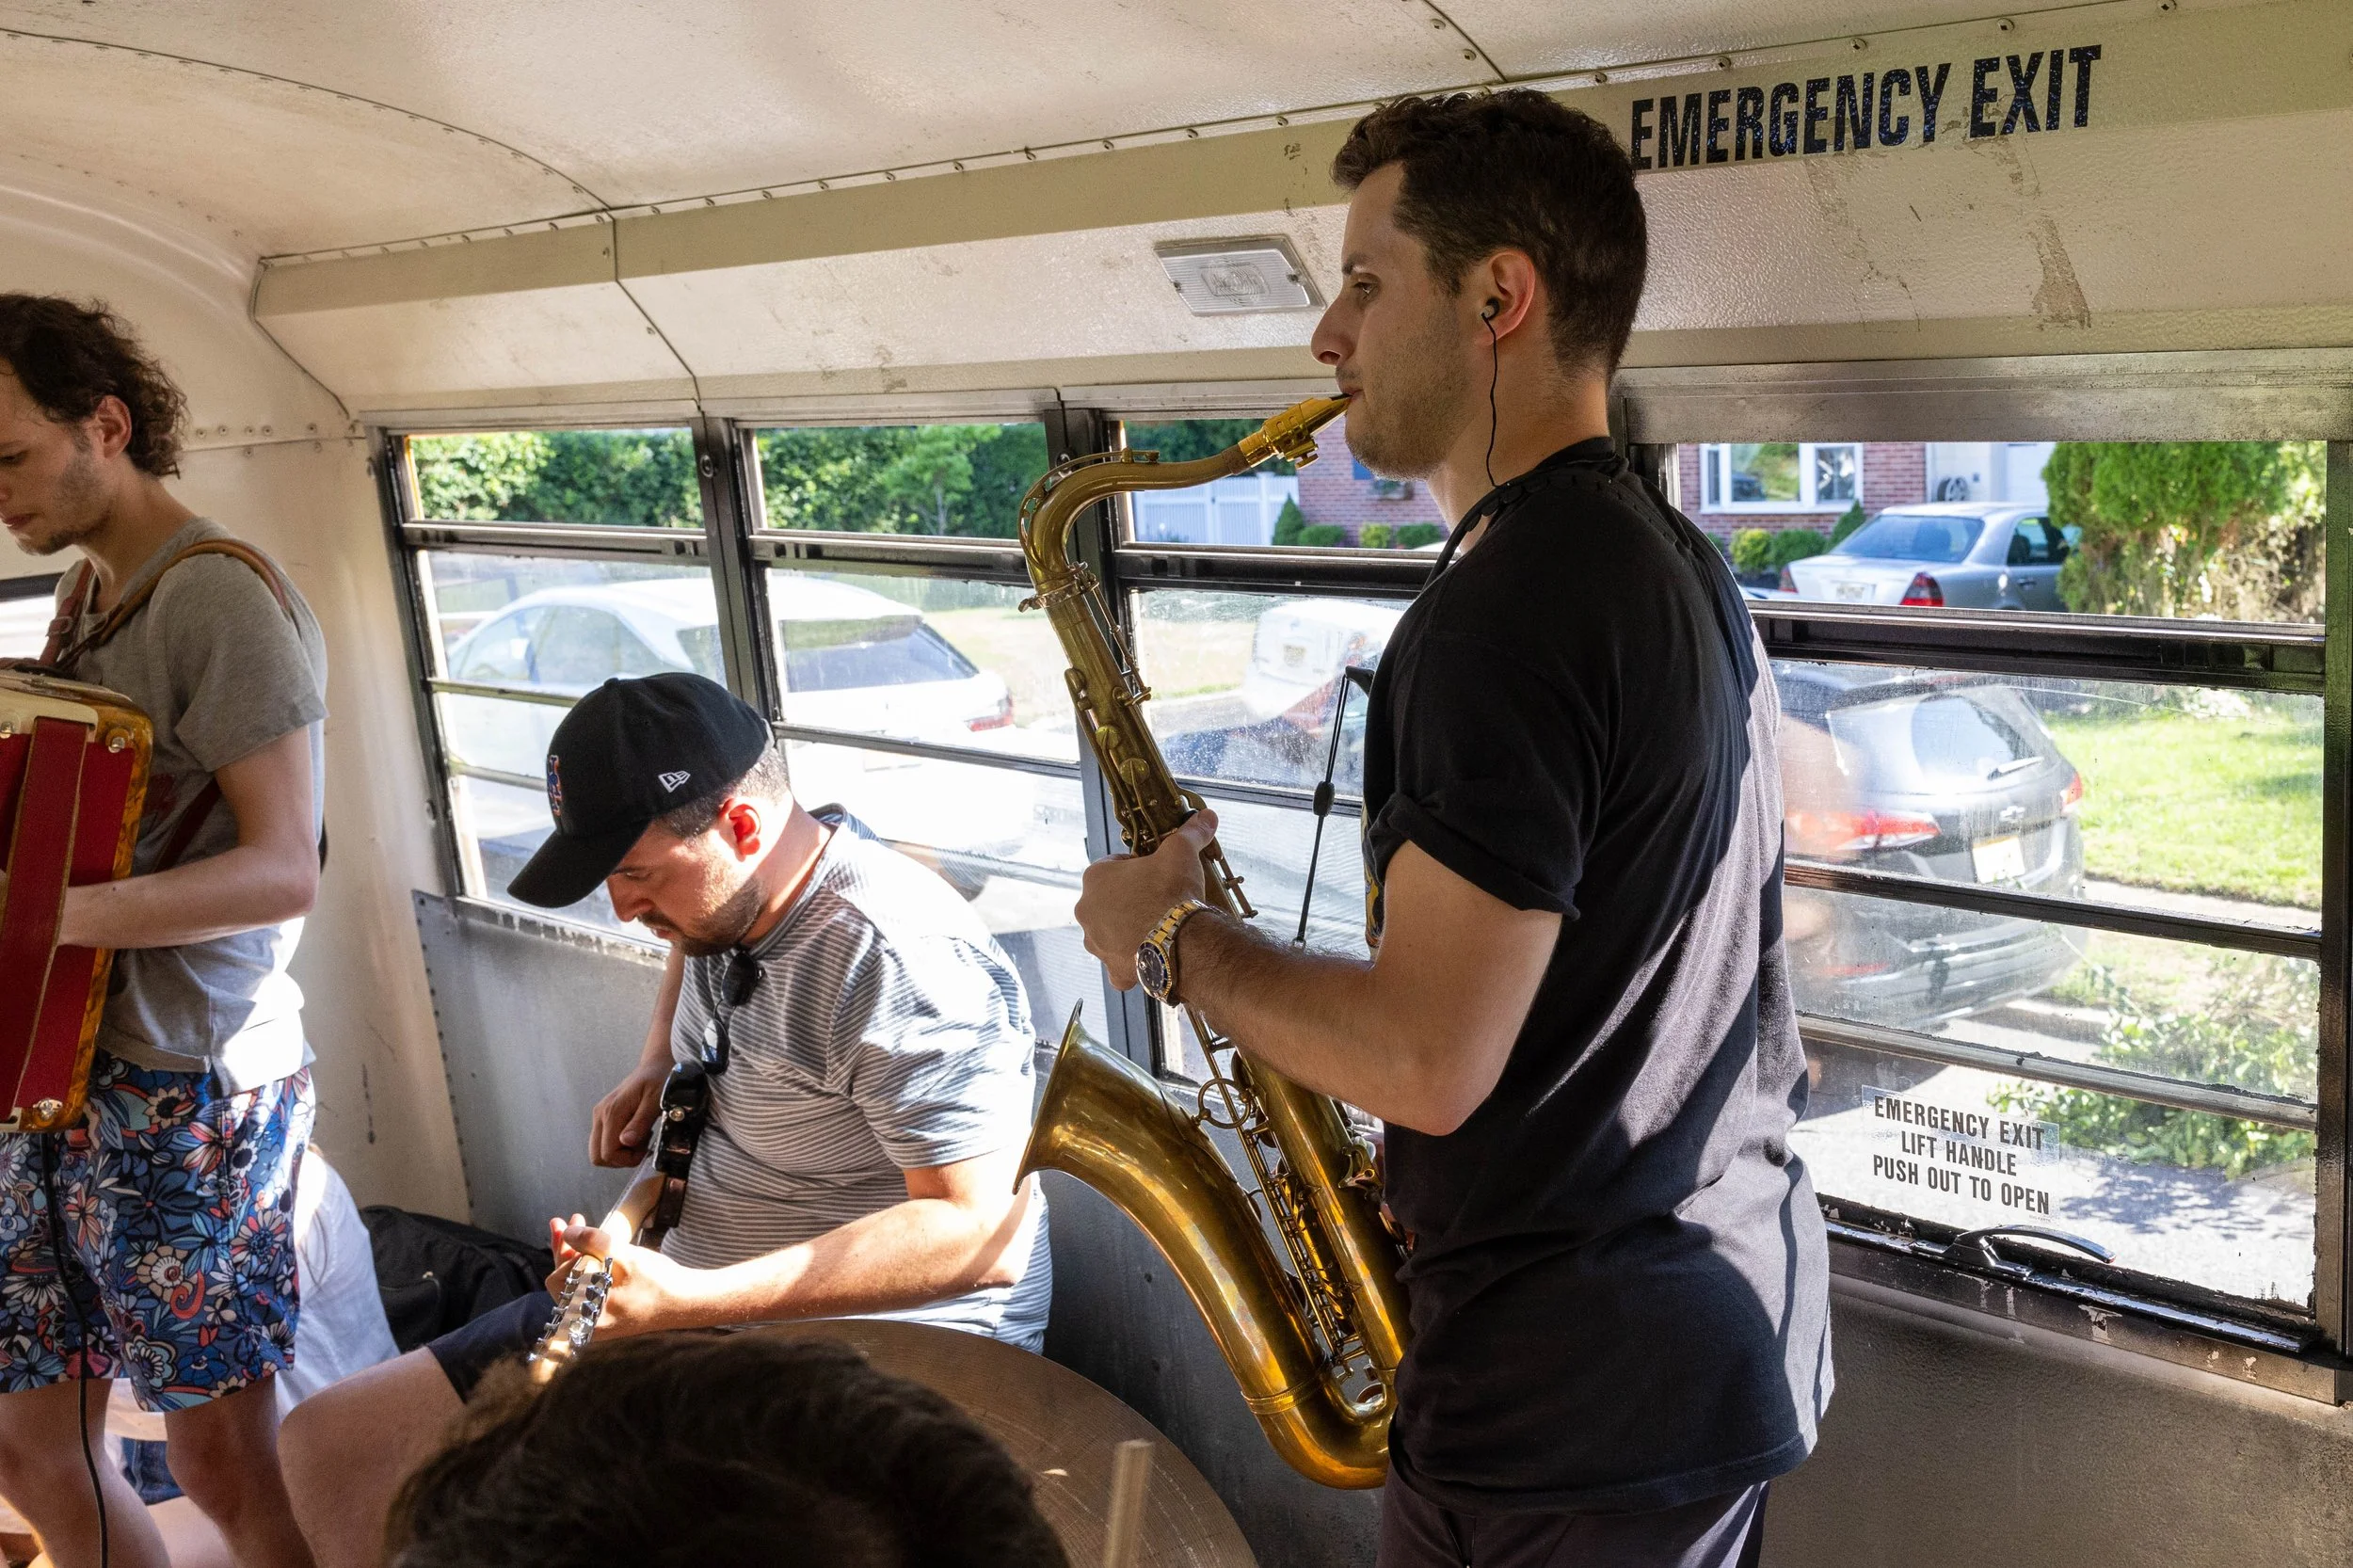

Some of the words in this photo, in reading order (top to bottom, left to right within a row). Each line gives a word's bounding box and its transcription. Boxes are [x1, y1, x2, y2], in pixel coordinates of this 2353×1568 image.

[1630, 63, 1952, 171] EMERGENCY
[1969, 44, 2102, 138] EXIT
[1875, 1096, 1989, 1140] EMERGENCY
[2000, 1121, 2045, 1151] EXIT
[1902, 1131, 1937, 1158] LIFT
[1946, 1141, 2017, 1176] HANDLE
[1874, 1155, 1918, 1185] PUSH
[1929, 1167, 1961, 1194] OUT
[1970, 1176, 1992, 1202] TO
[2002, 1183, 2049, 1215] OPEN
